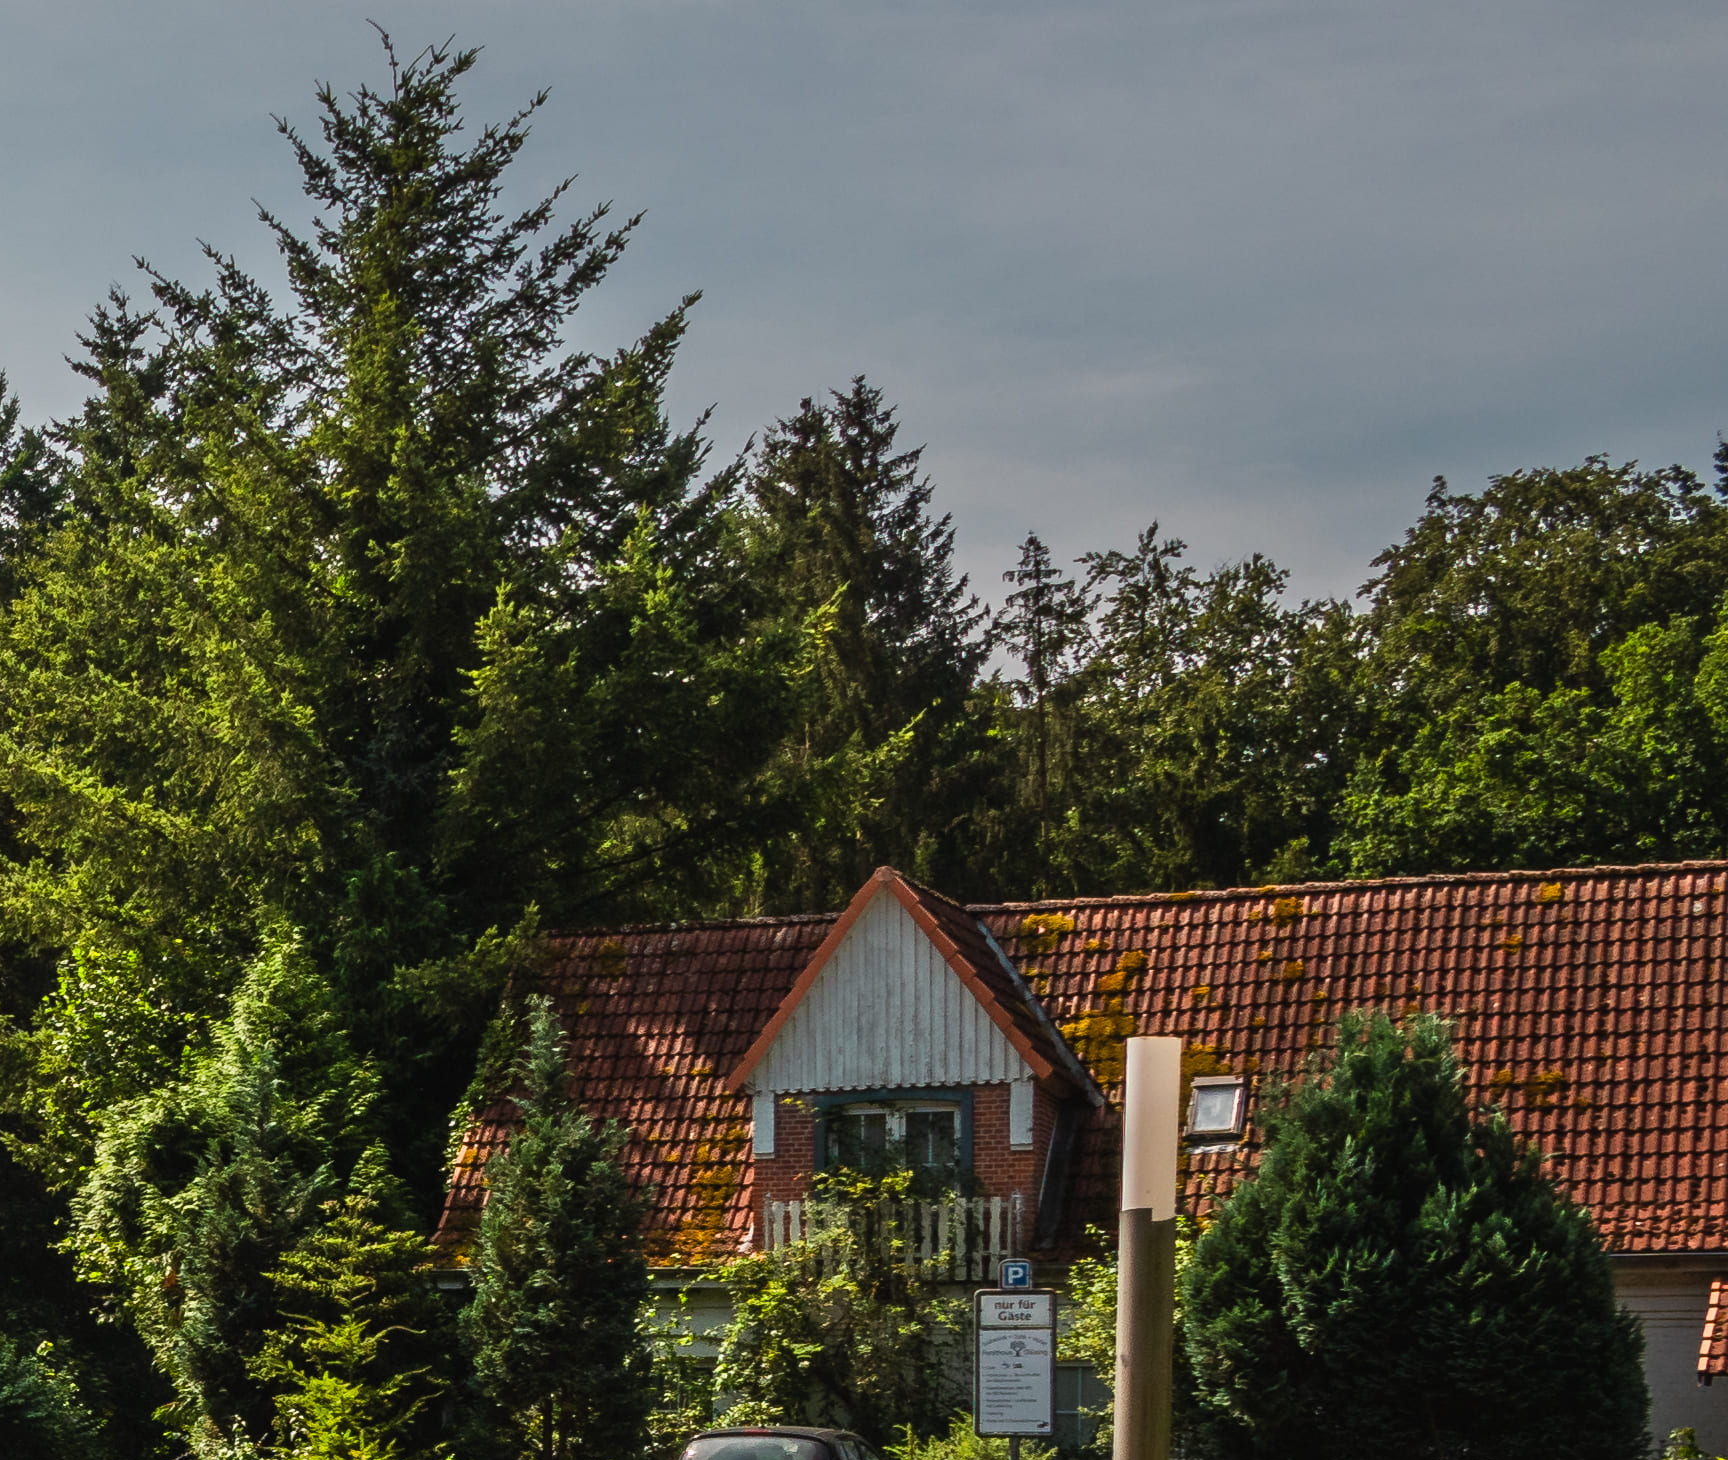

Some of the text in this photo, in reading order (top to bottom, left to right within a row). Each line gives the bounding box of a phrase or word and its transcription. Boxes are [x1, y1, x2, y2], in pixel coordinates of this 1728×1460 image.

[1008, 1267, 1024, 1284] P
[994, 1300, 1036, 1310] nur für
[998, 1311, 1032, 1321] Gäste
